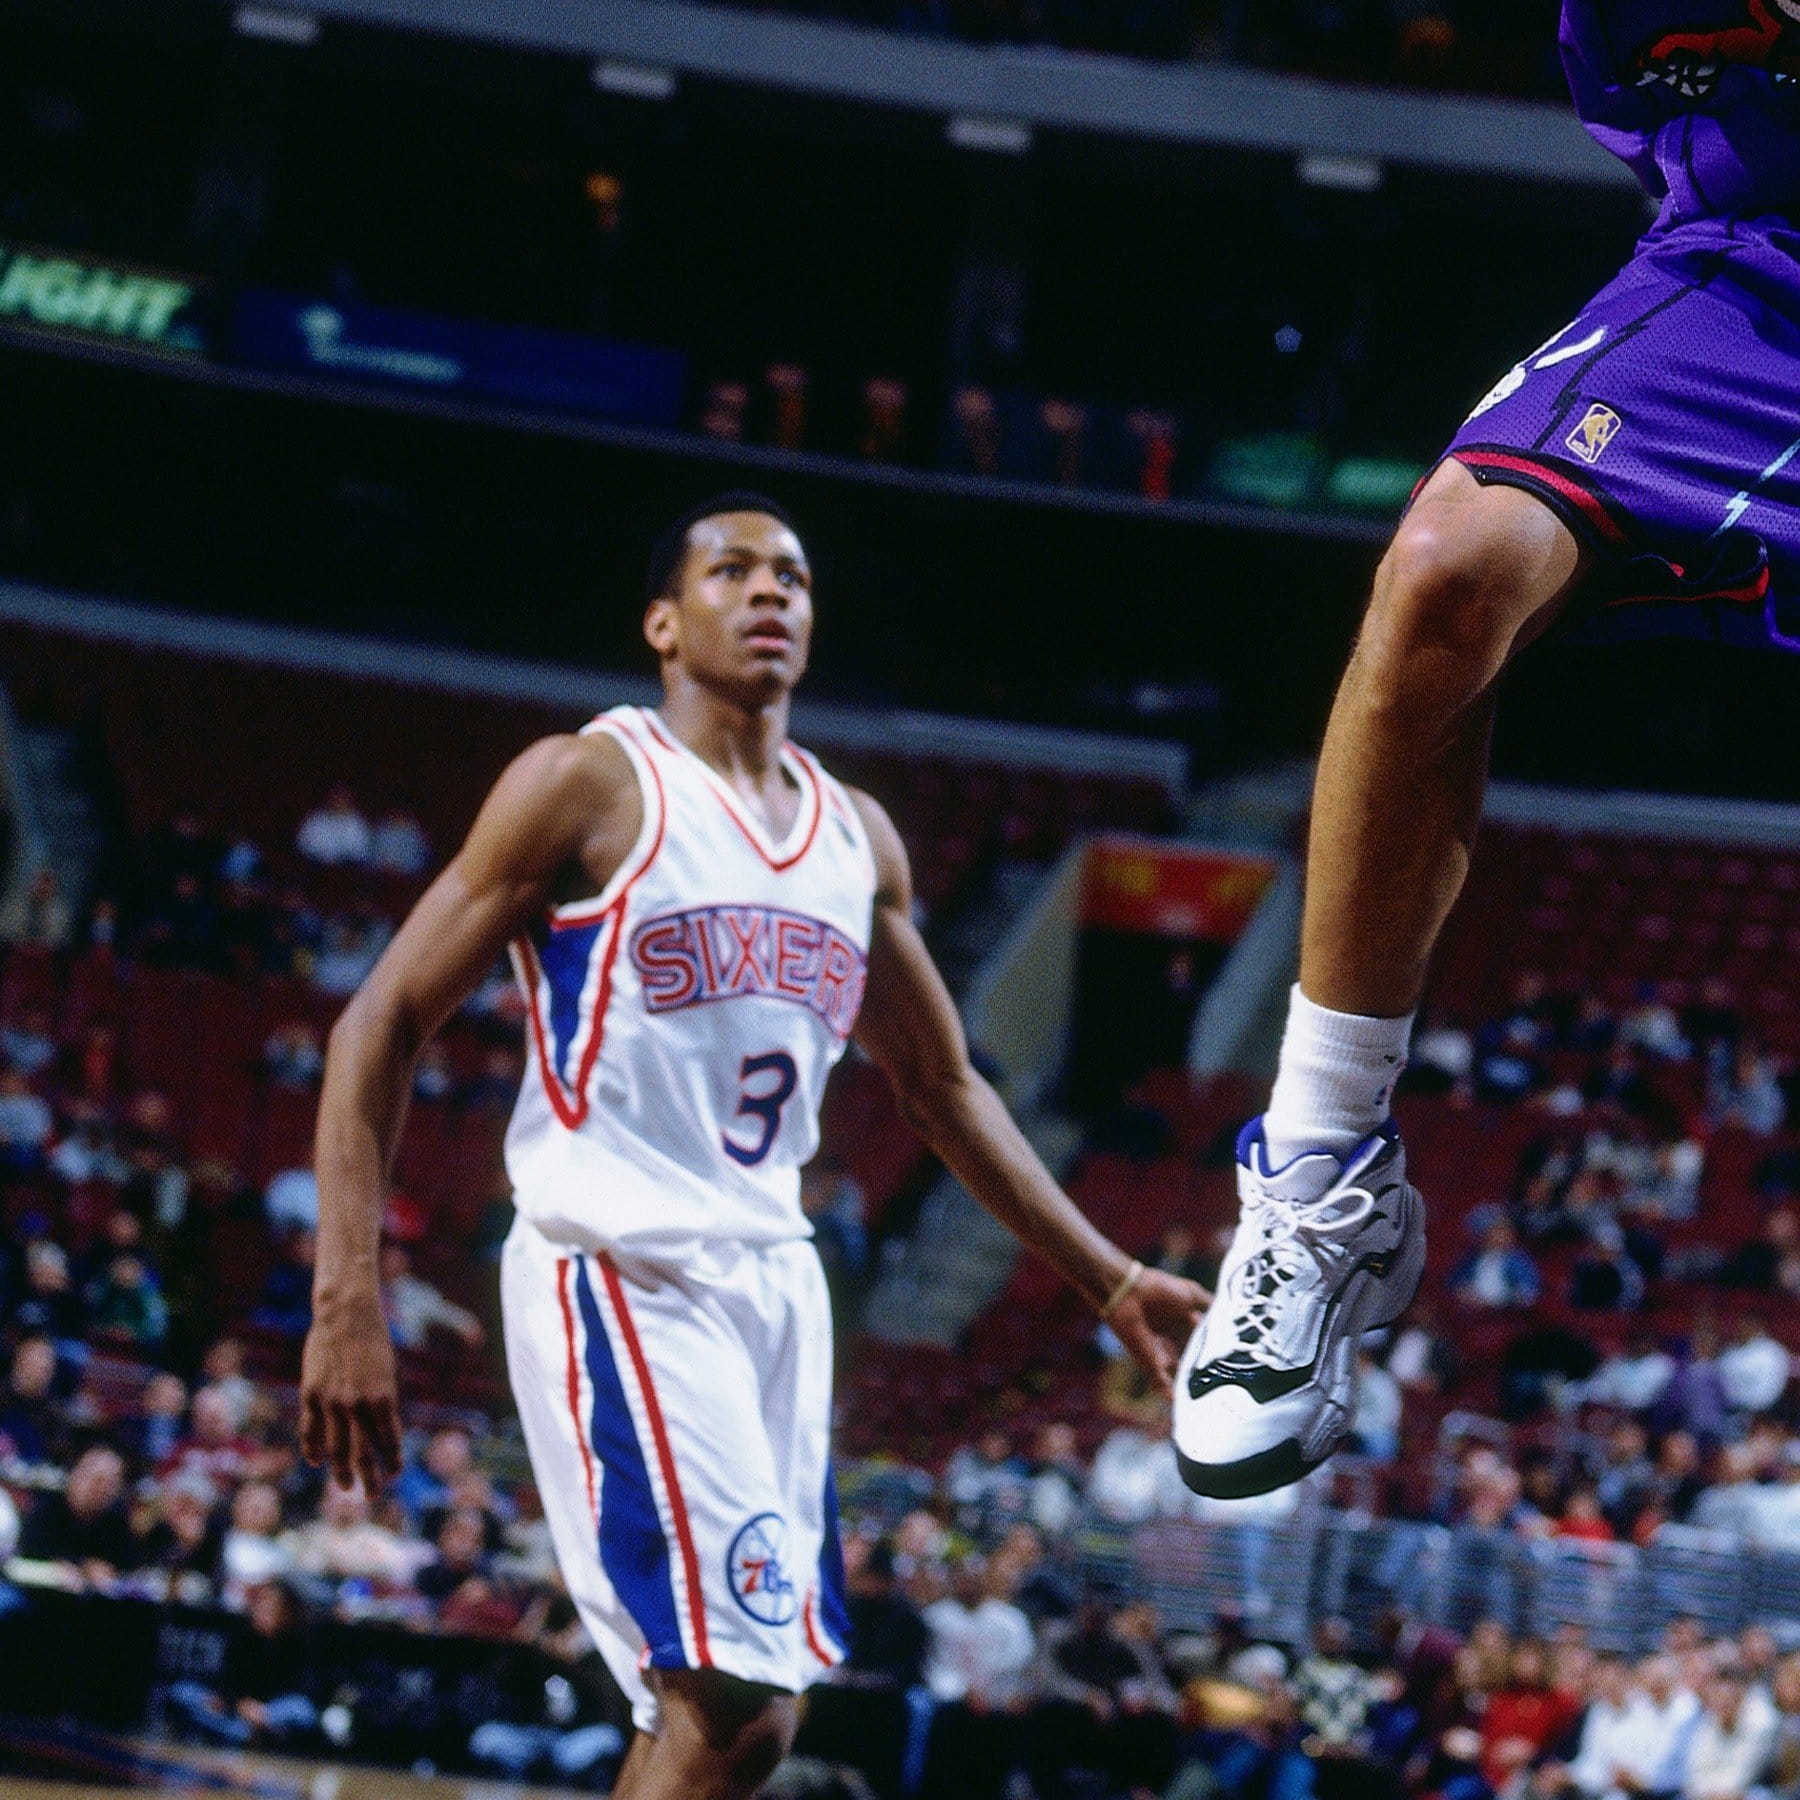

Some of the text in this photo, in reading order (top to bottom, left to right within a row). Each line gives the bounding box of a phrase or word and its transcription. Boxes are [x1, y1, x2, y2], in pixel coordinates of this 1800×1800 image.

[0, 250, 193, 338] IGHT
[630, 903, 867, 1039] SIXER
[720, 1048, 798, 1167] 3
